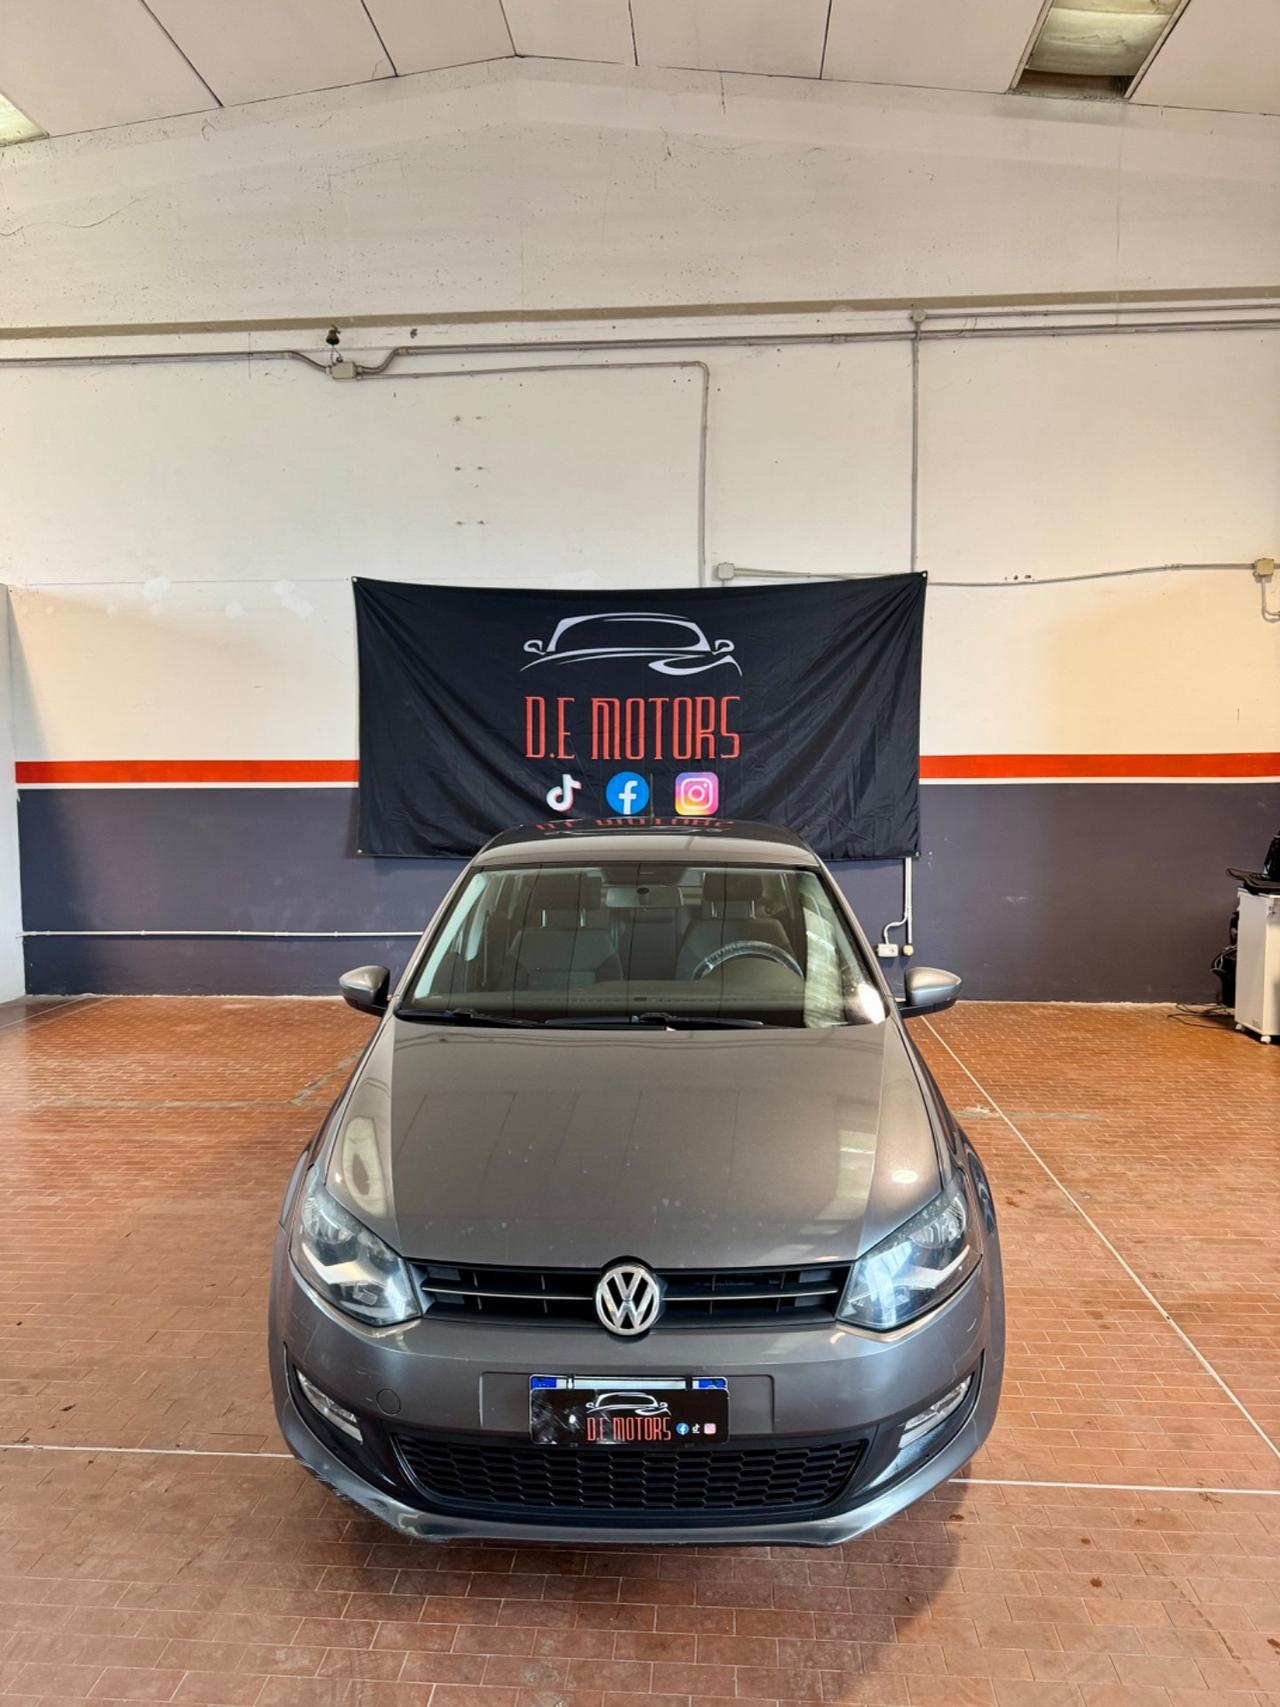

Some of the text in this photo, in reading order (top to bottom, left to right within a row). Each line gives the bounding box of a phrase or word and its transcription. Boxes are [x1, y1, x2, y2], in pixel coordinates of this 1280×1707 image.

[525, 696, 740, 760] D.E MOTORS
[618, 780, 638, 815] f
[597, 1265, 660, 1336] VW
[613, 1416, 672, 1441] MOTORS
